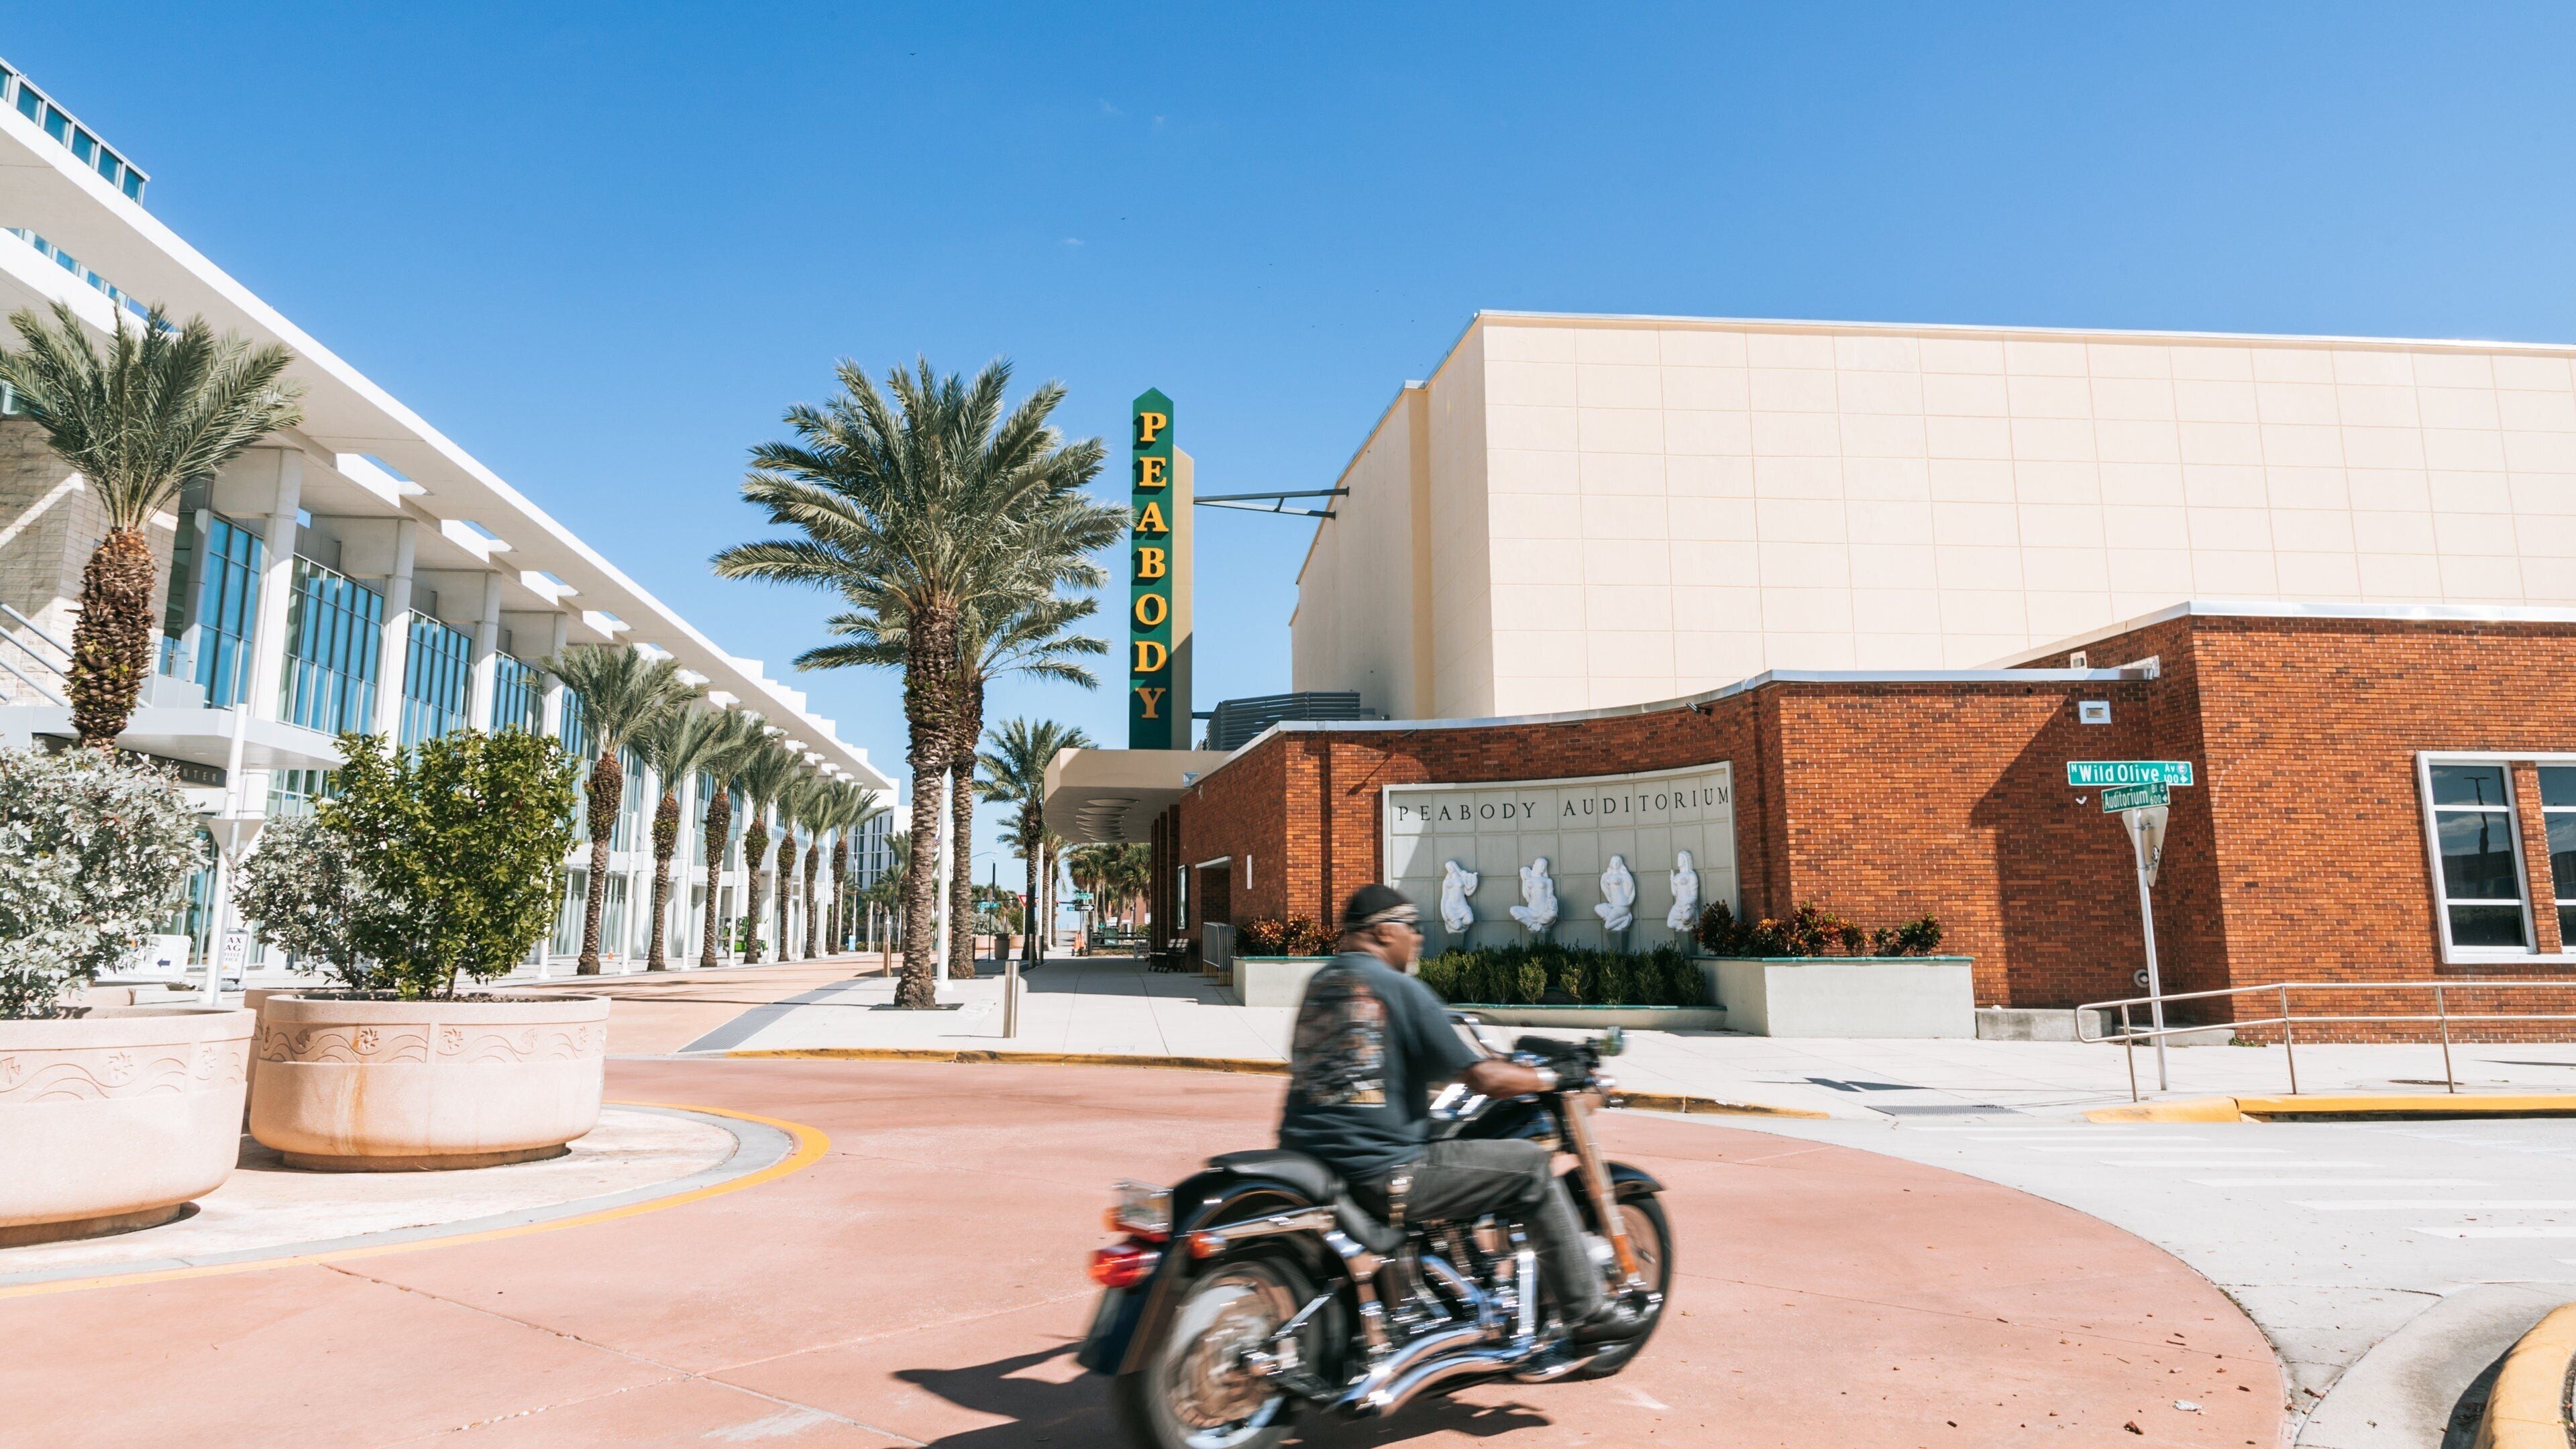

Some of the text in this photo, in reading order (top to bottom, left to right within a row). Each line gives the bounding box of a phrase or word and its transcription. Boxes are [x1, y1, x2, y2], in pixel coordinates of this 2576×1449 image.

[1135, 412, 1169, 718] PEABODY
[2071, 763, 2175, 782] N Wild Olive Av
[2164, 774, 2179, 784] 100
[1399, 786, 1729, 820] PEABODY AUDITORIUM
[2104, 789, 2147, 809] Auditorium
[2150, 795, 2161, 804] 600
